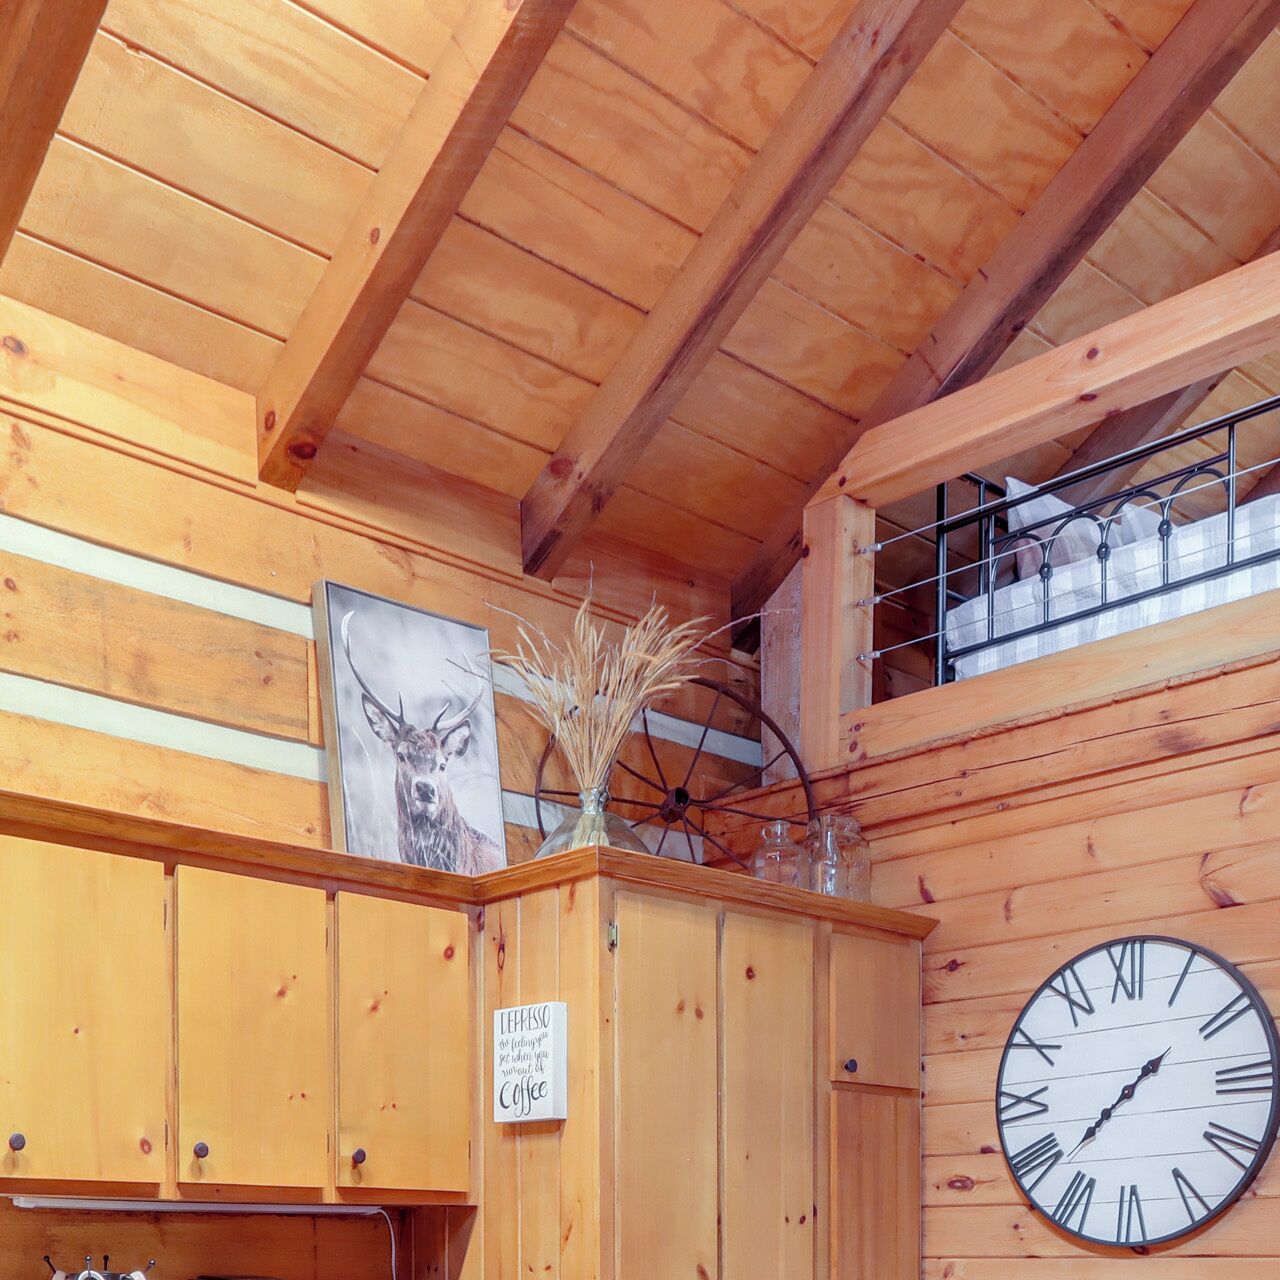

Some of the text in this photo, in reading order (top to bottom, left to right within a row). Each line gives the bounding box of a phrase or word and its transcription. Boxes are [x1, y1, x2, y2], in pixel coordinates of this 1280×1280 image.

[500, 1004, 551, 1036] DEPRESSO
[511, 1035, 535, 1053] feeling
[499, 1052, 511, 1067] get
